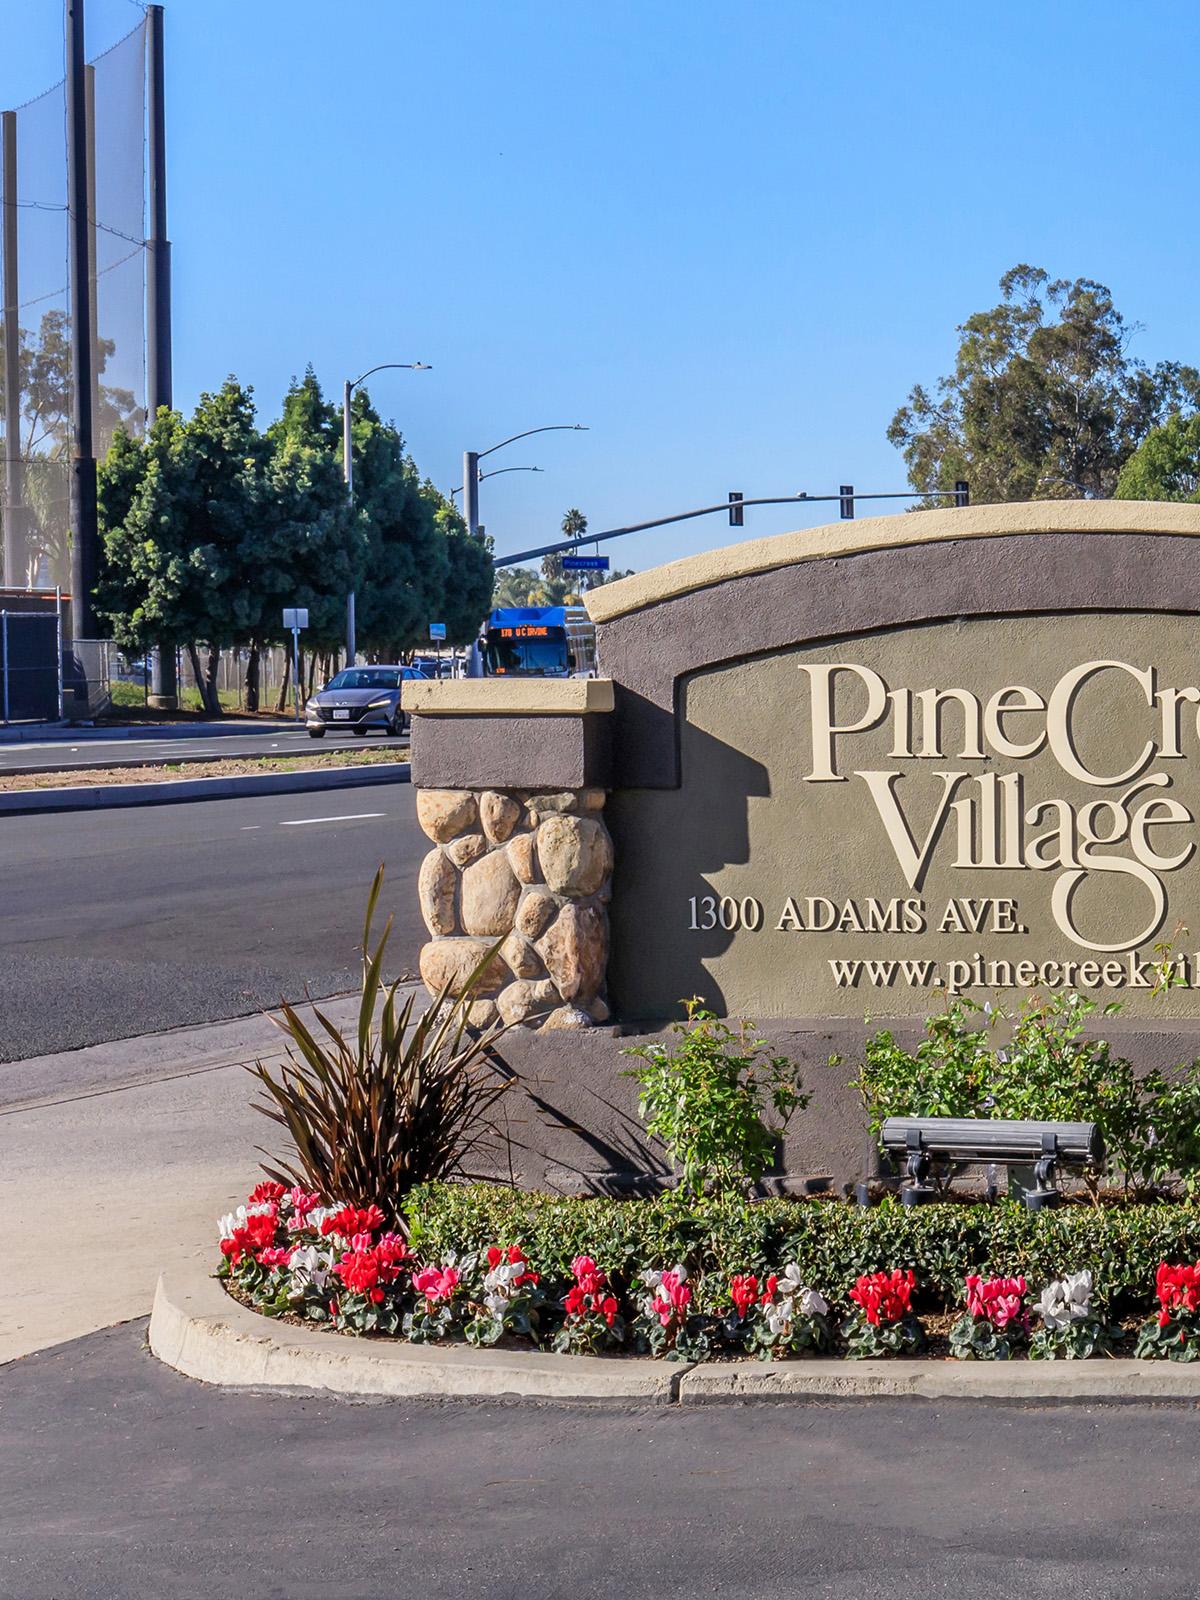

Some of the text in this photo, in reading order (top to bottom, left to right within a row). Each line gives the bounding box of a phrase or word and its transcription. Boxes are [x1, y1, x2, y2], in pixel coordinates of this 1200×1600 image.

[688, 896, 1025, 933] 1300 ADAMS AVE.
[853, 771, 1195, 952] Village
